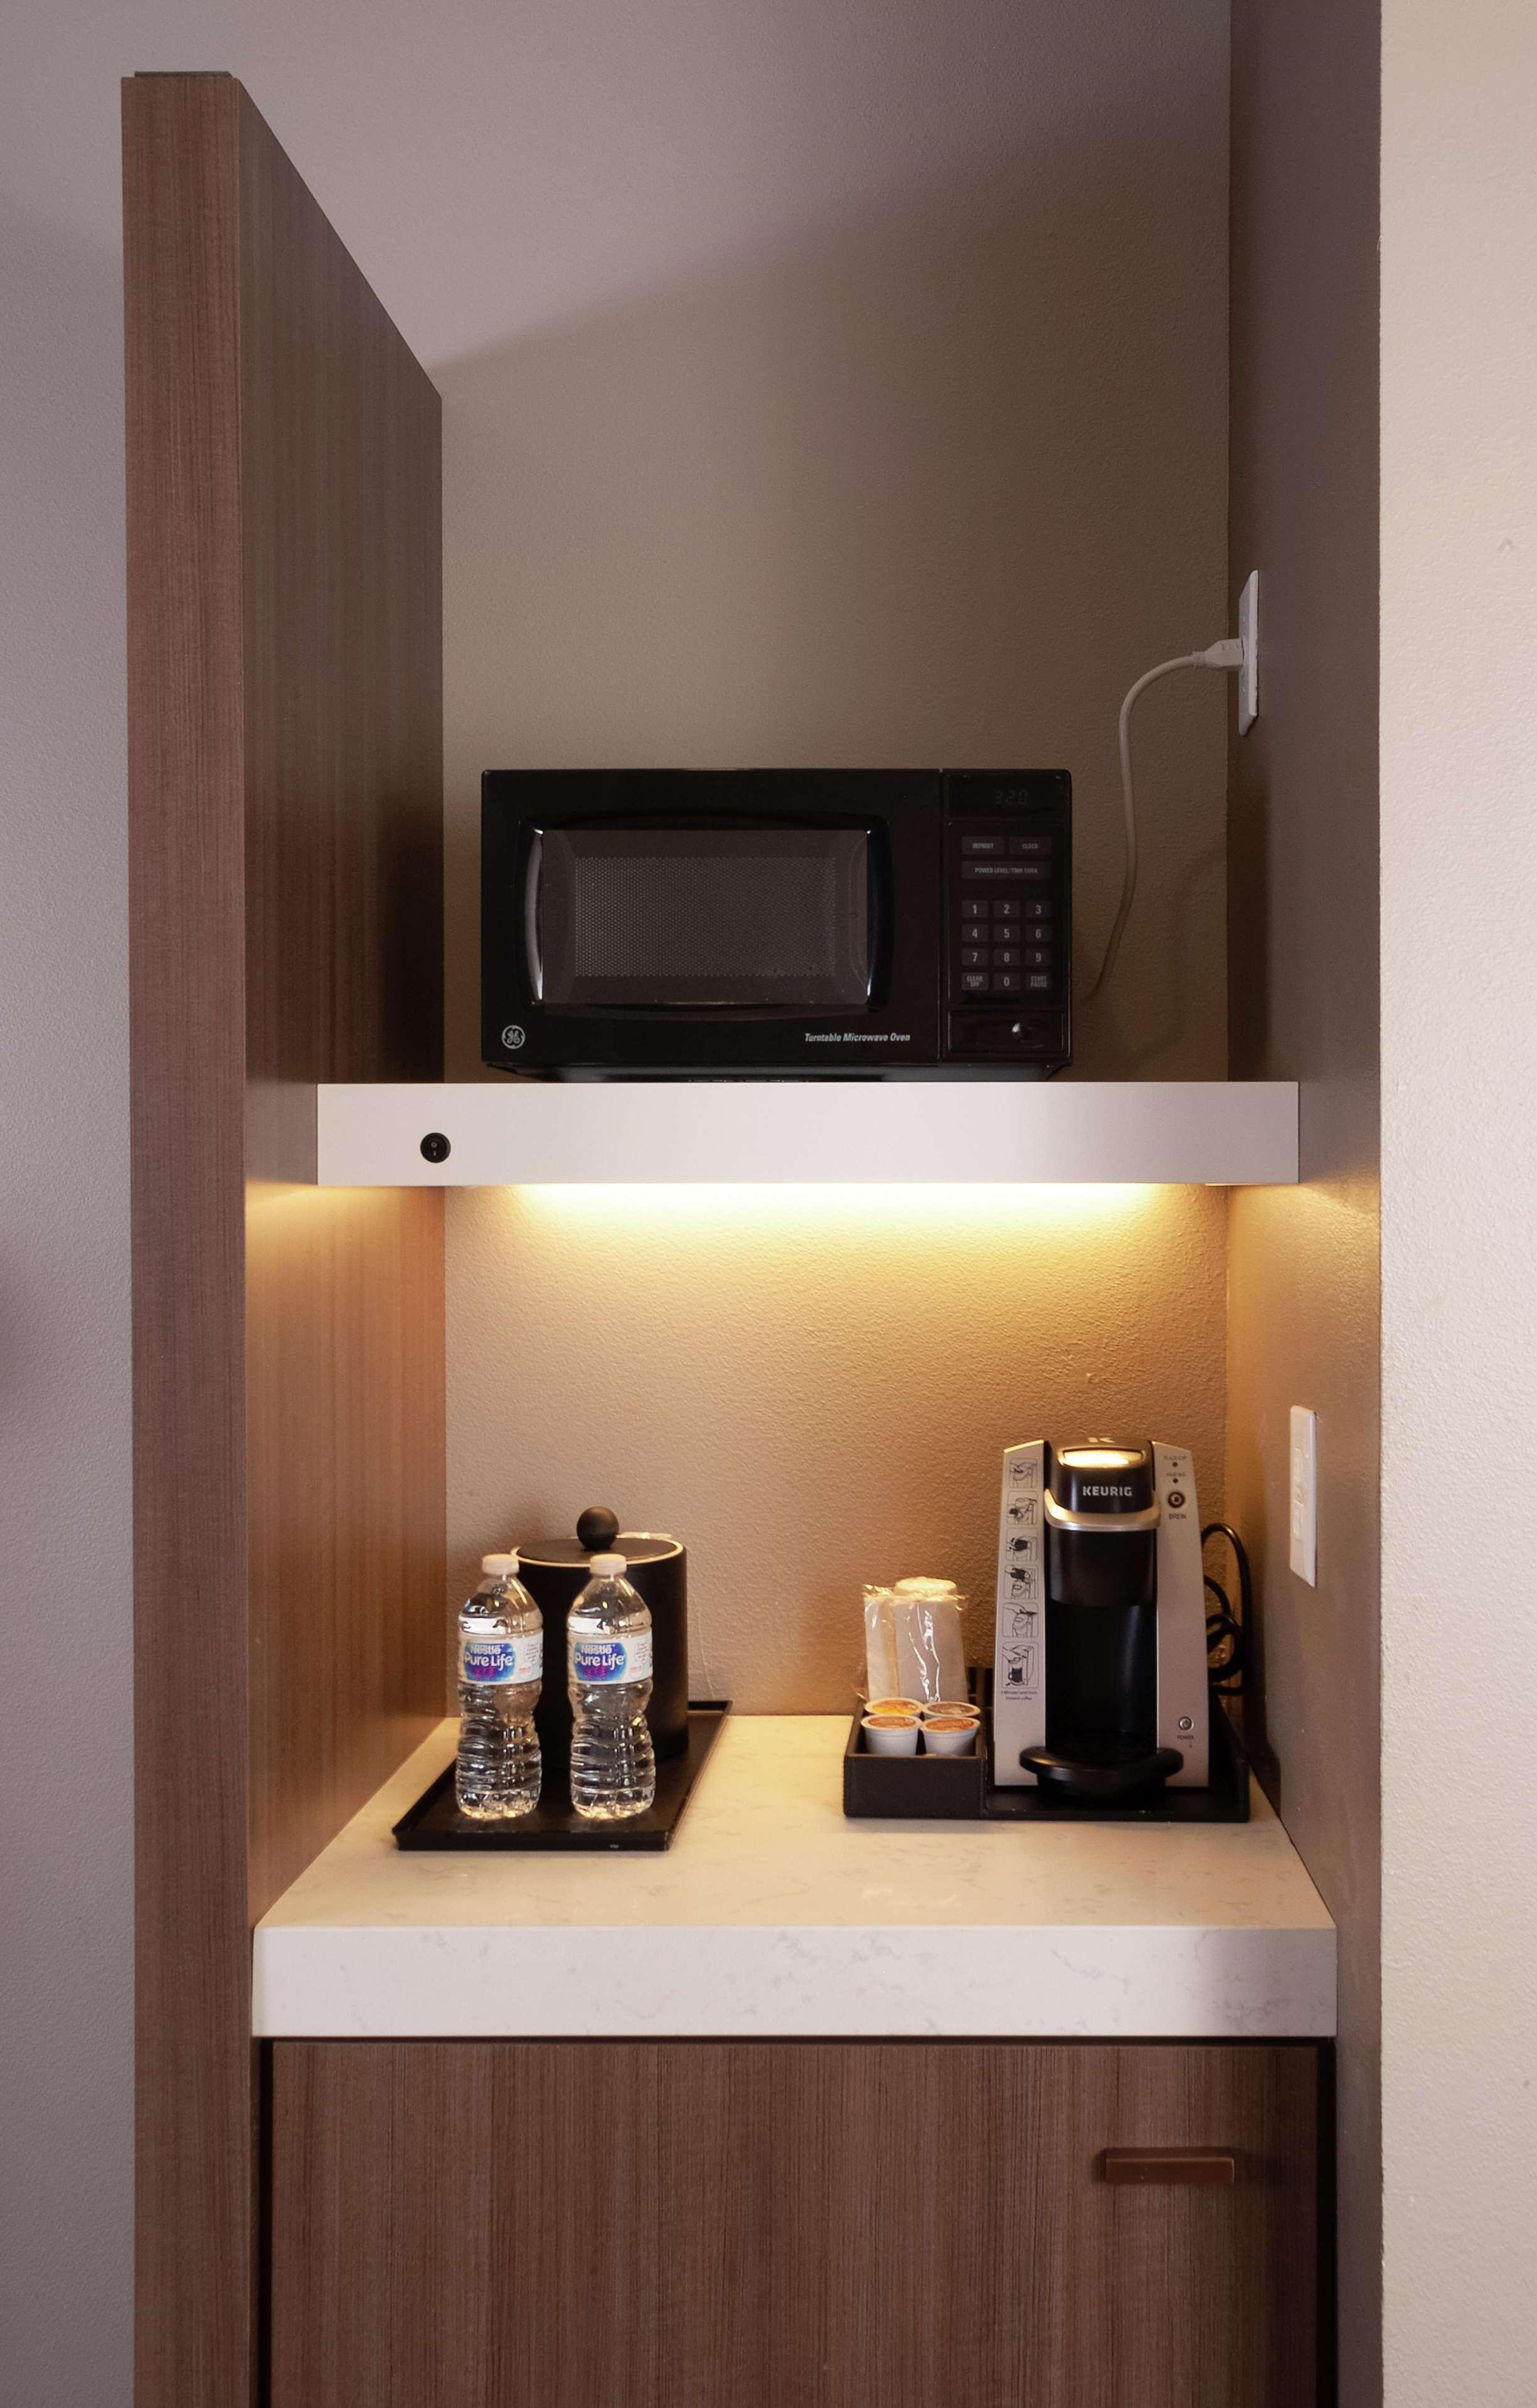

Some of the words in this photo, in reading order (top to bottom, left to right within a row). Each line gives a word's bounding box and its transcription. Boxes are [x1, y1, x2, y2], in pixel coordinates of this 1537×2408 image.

[972, 904, 977, 914] 1
[1004, 904, 1010, 914] 2
[1035, 904, 1041, 915] 3
[972, 928, 978, 938] 4
[1004, 928, 1010, 938] 5
[1035, 929, 1041, 938] 6
[972, 952, 978, 962] 7
[1004, 953, 1010, 962] 8
[1035, 953, 1041, 963] 9
[1004, 977, 1009, 987] 0
[805, 1033, 842, 1042] Turntable
[843, 1032, 888, 1042] Microwave
[890, 1032, 911, 1041] Oven
[1082, 1485, 1132, 1497] KEURIG
[465, 1652, 489, 1667] Pure
[491, 1653, 513, 1671] Life
[575, 1652, 601, 1667] Pure
[602, 1653, 624, 1670] Life
